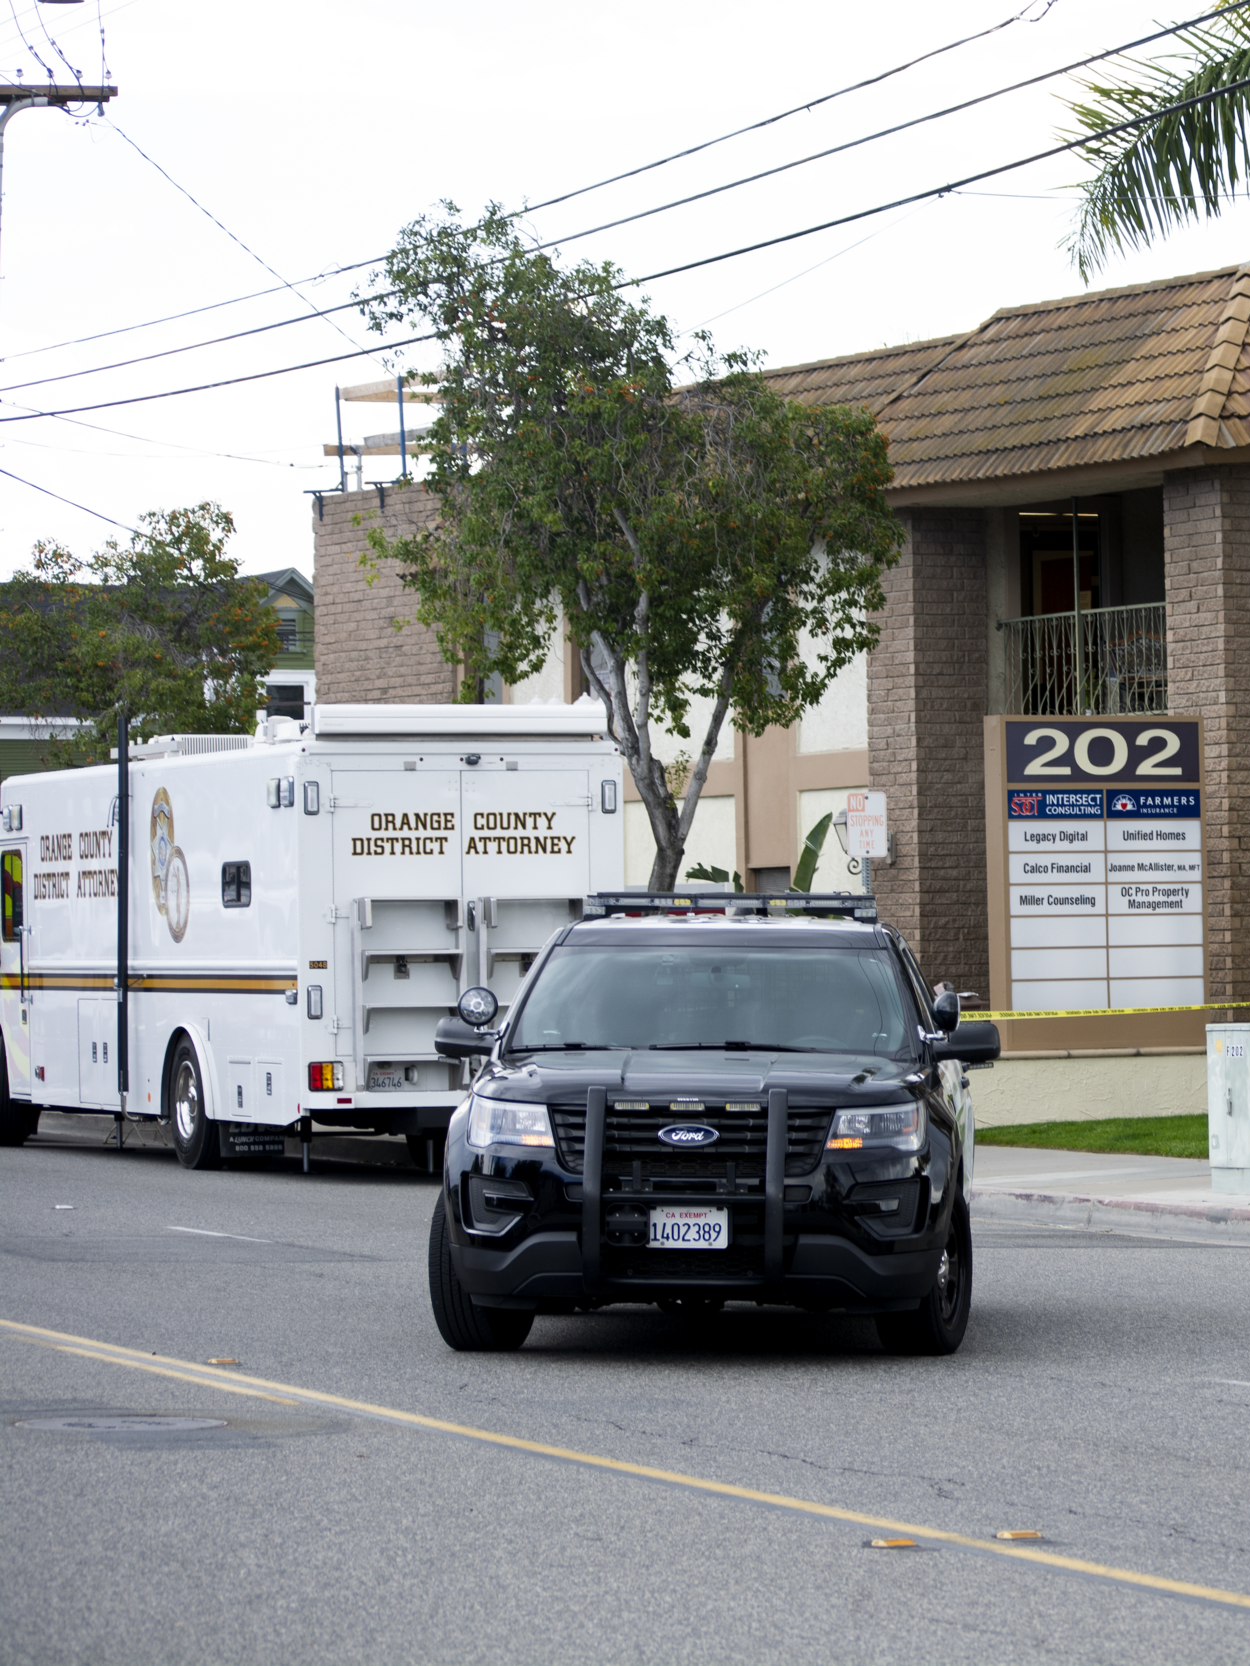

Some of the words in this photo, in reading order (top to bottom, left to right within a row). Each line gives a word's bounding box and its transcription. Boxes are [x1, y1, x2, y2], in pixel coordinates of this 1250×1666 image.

[1023, 727, 1183, 776] 202
[850, 795, 864, 810] NO
[1045, 793, 1102, 805] INTERSECT
[1139, 796, 1195, 806] FARMERS
[1045, 806, 1101, 815] CONSULTING
[370, 812, 455, 832] ORANGE
[473, 811, 557, 831] COUNTY
[850, 814, 884, 827] STOPPING
[859, 829, 874, 838] ANY
[1024, 831, 1057, 844] Legacy
[1059, 830, 1088, 844] Digital
[1122, 829, 1154, 842] Unified
[1156, 829, 1186, 841] Homes
[40, 832, 73, 863] ORANGE
[78, 829, 113, 860] COUNTY
[351, 836, 449, 856] DISTRICT
[465, 835, 577, 855] ATTORNEY
[859, 839, 875, 849] TIME
[1023, 862, 1049, 874] Calco
[1050, 862, 1091, 874] Financial
[1108, 862, 1136, 872] Joanne
[1137, 862, 1177, 873] McAllister,
[1177, 864, 1188, 872] MA,
[33, 871, 70, 901] DISTRICT
[1120, 886, 1133, 898] OC
[1135, 886, 1150, 897] Pro
[1152, 886, 1189, 899] Property
[1019, 894, 1045, 906] Miller
[1047, 894, 1096, 908] Counseling
[1127, 899, 1183, 911] Management
[309, 961, 327, 969] 5048
[370, 1076, 402, 1088] 346746
[671, 1128, 705, 1141] Ford
[650, 1222, 722, 1242] 1402389
